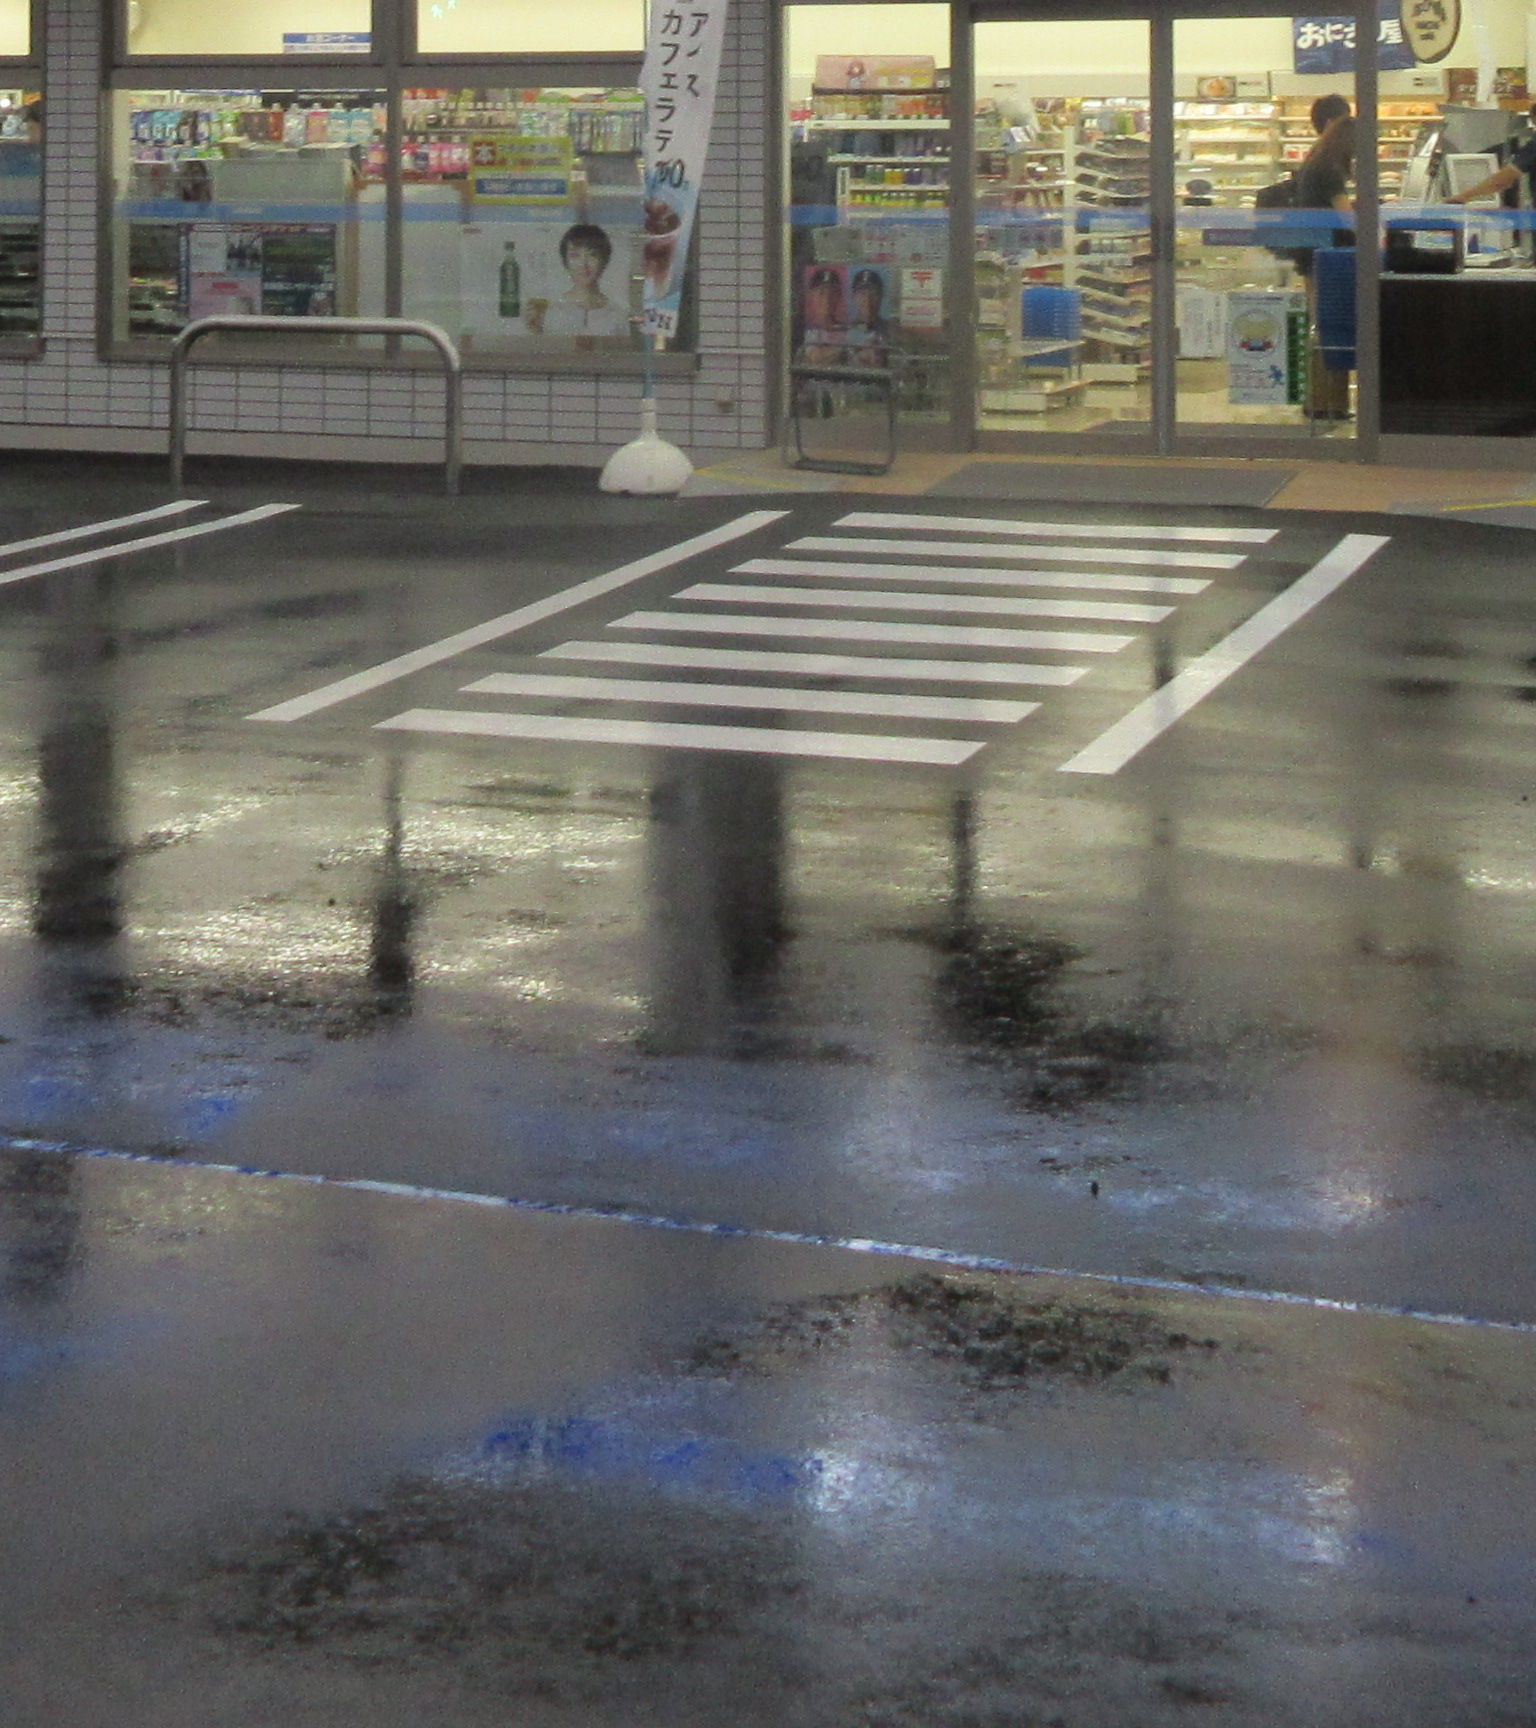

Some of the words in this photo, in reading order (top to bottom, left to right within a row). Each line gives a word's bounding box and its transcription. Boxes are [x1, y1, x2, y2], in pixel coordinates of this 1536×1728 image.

[655, 9, 683, 152] カフェラテ
